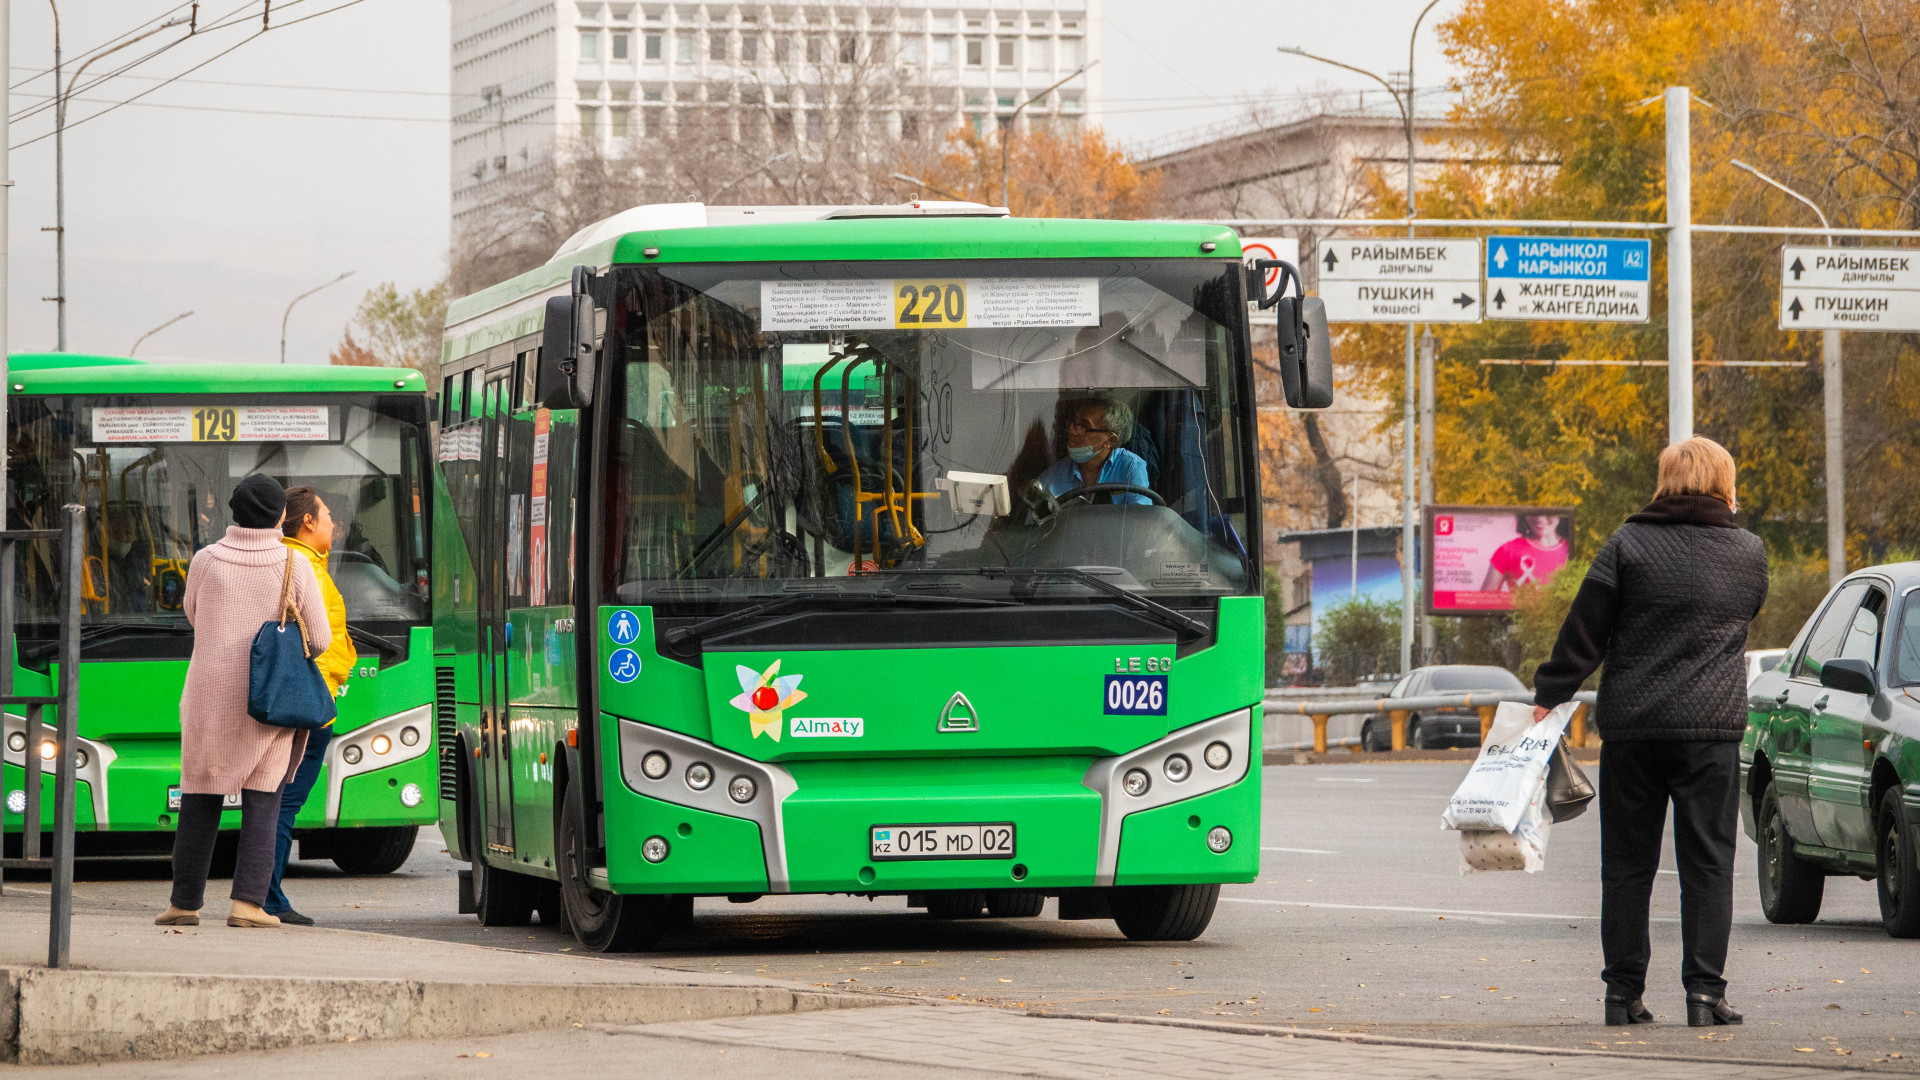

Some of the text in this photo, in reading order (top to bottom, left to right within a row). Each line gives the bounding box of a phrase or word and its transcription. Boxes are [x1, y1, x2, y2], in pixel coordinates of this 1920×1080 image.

[1352, 244, 1446, 260] РАЙЫМБЕК
[1519, 242, 1607, 258] НАРЫНҚОЛ
[1379, 264, 1433, 274] даңғылы
[1518, 260, 1606, 275] НАРЫНКОЛ
[1817, 253, 1909, 271] РАЙЫМБЕК
[1842, 272, 1894, 282] даңғылы
[1358, 287, 1434, 300] ПУШКИН
[1519, 283, 1616, 298] ЖАНГЕЛДИН
[899, 284, 964, 323] 220
[1373, 305, 1420, 314] көшесі
[1532, 301, 1639, 316] ЖАНГЕЛДИНА
[1815, 297, 1888, 311] ПУШКИН
[195, 409, 235, 440] 129
[359, 667, 377, 678] 60
[1115, 657, 1171, 673] LE 60
[1109, 680, 1162, 709] 0026
[794, 720, 859, 735] Almaty
[875, 829, 1010, 852] KZ 015 MD 02
